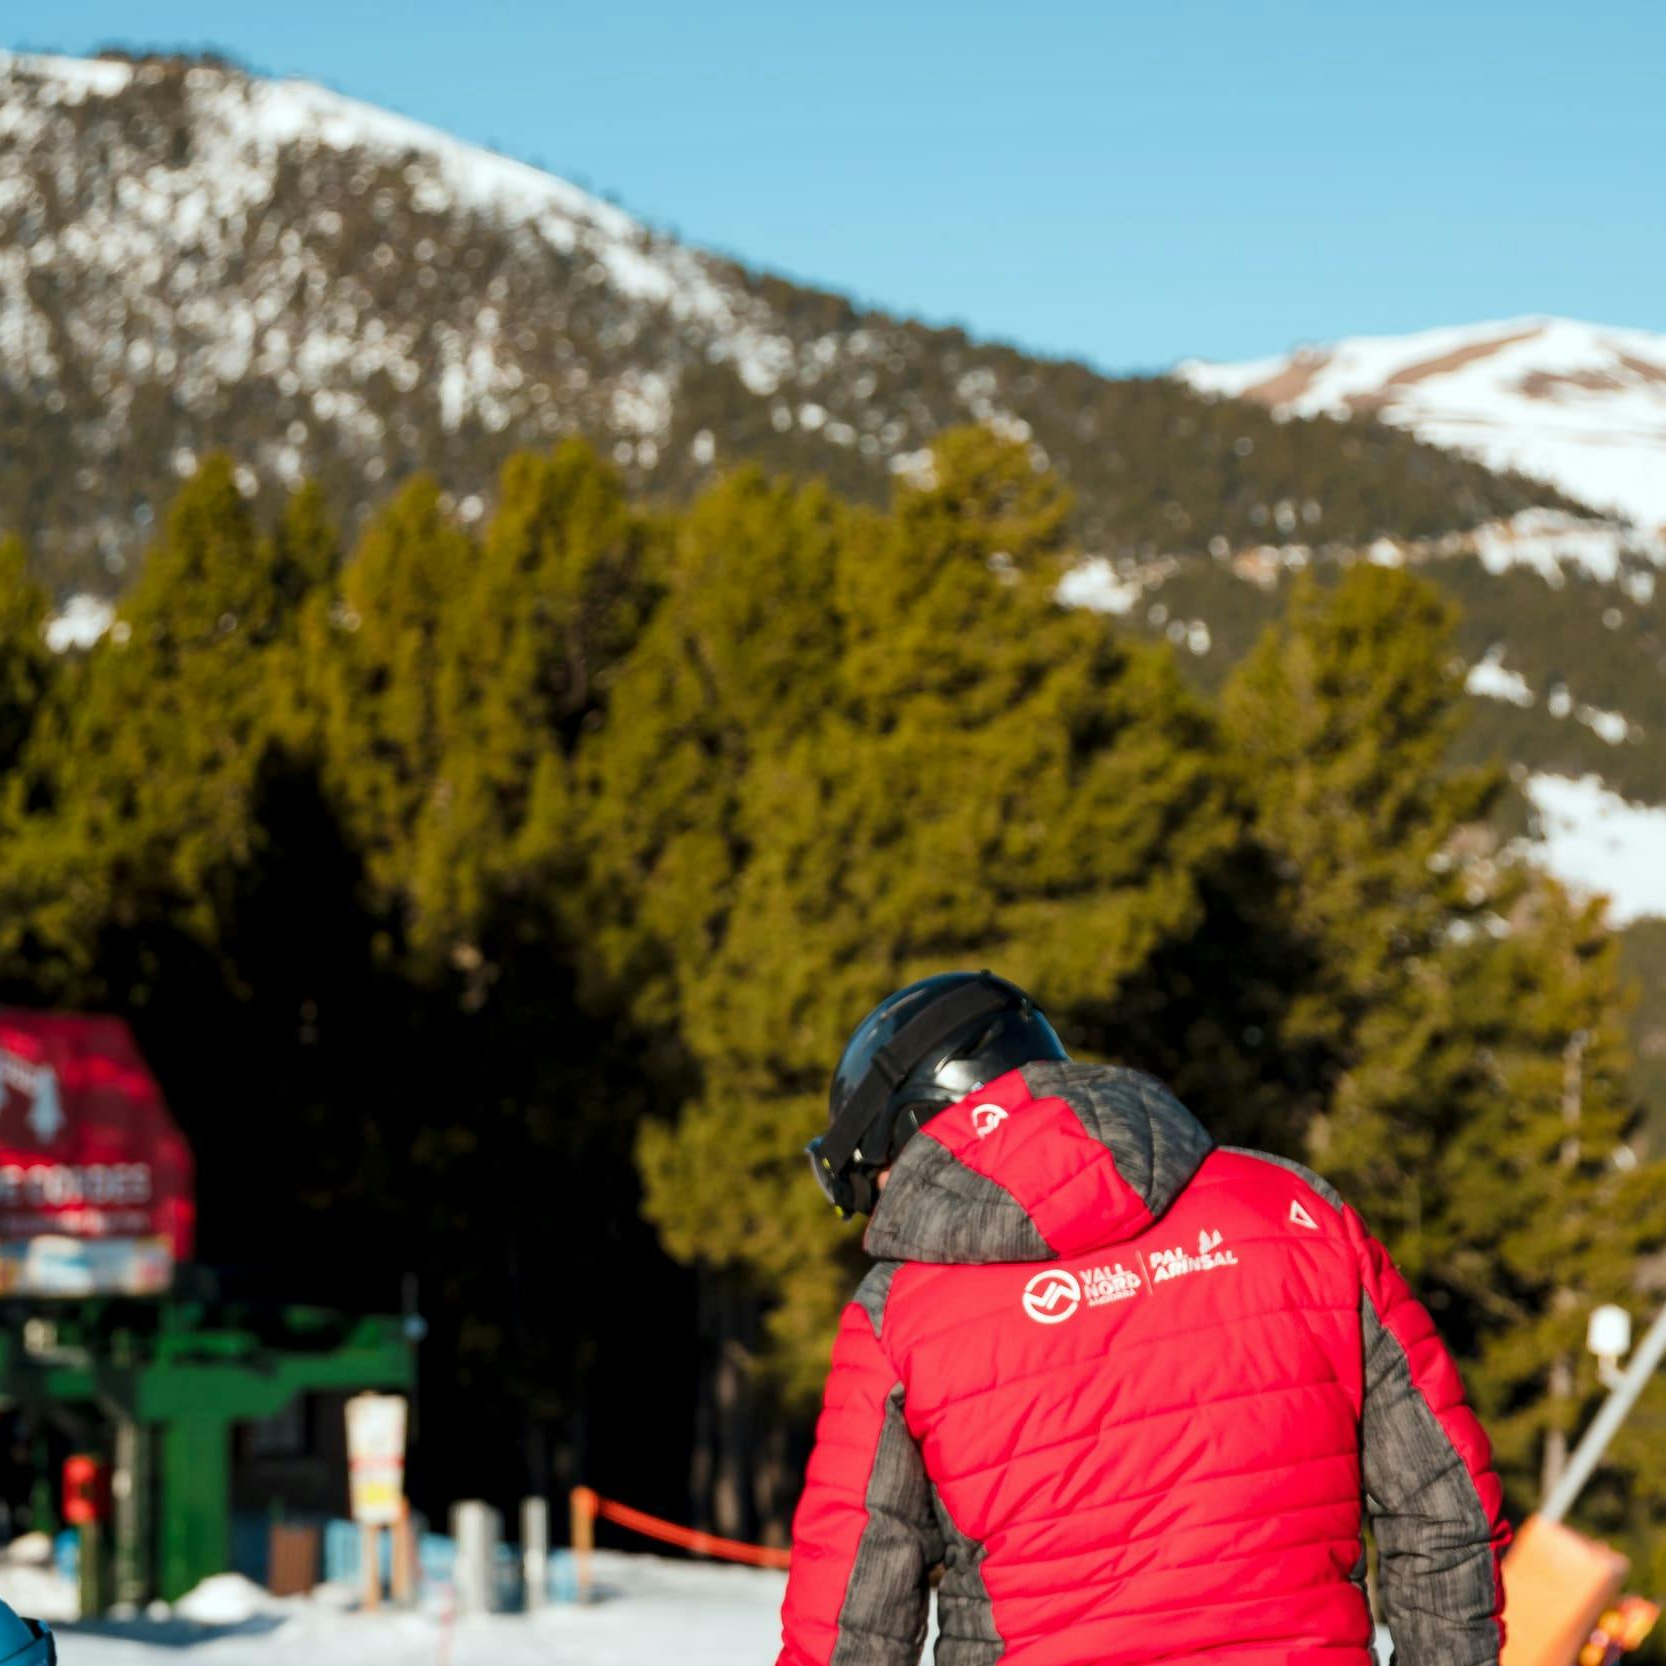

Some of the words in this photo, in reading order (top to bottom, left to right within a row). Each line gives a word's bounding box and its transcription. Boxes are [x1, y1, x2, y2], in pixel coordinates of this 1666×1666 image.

[1149, 1247, 1187, 1269] PAL
[1079, 1263, 1130, 1284] VALL
[1083, 1271, 1141, 1298] NORD
